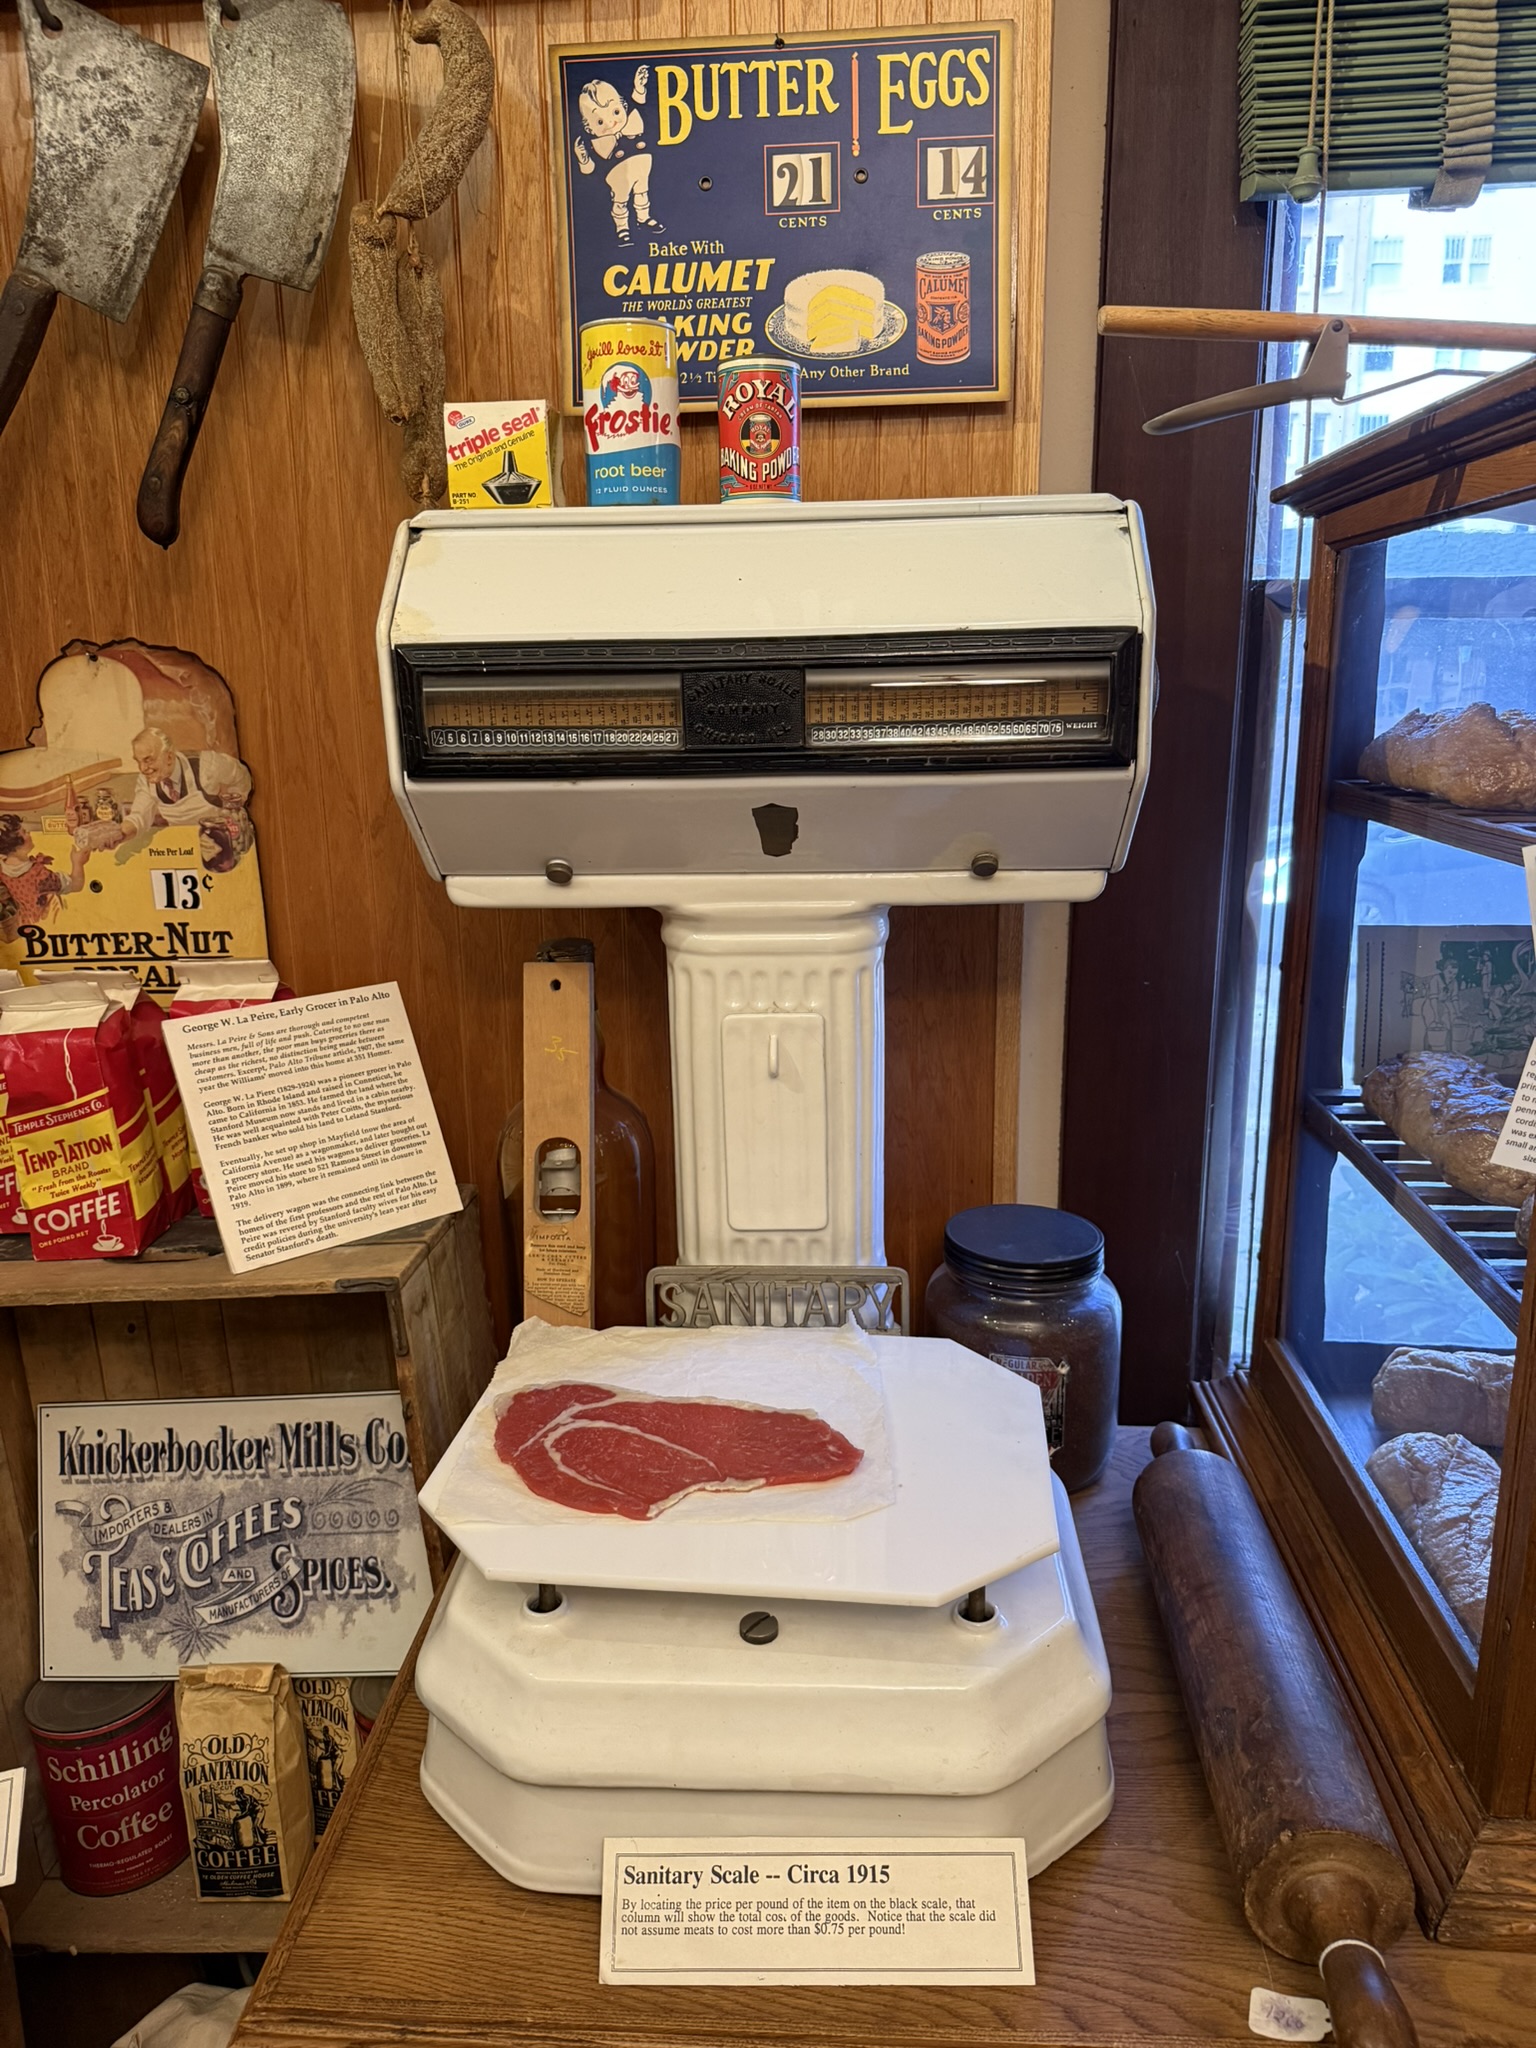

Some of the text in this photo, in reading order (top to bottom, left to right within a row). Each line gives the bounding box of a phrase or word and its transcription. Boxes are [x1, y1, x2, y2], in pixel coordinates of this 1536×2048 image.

[655, 47, 990, 146] BUTTER EGGS
[777, 146, 987, 207] 21 14
[778, 207, 982, 228] CENTS CENTS
[649, 240, 725, 257] Bake With
[602, 258, 776, 297] CALUMET
[919, 277, 968, 300] CALUMET
[621, 295, 753, 313] THE WORLD'S GREATEST
[616, 340, 647, 356] love
[800, 363, 910, 381] Any Other Brand
[722, 379, 796, 421] ROYAL
[448, 407, 540, 462] triple seal
[585, 402, 671, 452] Frostie
[454, 429, 535, 472] The Original and Genuine
[594, 462, 666, 479] root beer
[632, 485, 668, 494] OUNCES
[988, 721, 1098, 734] 52 55 60 65 70 75 WEIGHT
[149, 847, 194, 857] Price Per Loaf
[17, 922, 234, 960] BUTTER-NUT
[182, 991, 390, 1034] George W. La Peire, Early Grocer in Palo Alto
[1522, 1094, 1531, 1102] to
[12, 1120, 46, 1136] TEMPLE
[45, 1106, 91, 1127] STEPHENS
[1511, 1128, 1527, 1138] was
[17, 1133, 113, 1176] TEMP-TATION
[1505, 1139, 1528, 1149] small
[52, 1161, 90, 1179] BRAND
[58, 1177, 75, 1190] from
[76, 1173, 87, 1182] the
[50, 1188, 70, 1199] Twice
[33, 1191, 122, 1235] COFFEE
[38, 1229, 89, 1249] ONE POUND NET
[245, 1231, 339, 1262] Senator Stanford's death.
[659, 1281, 900, 1330] SANITARY
[57, 1425, 271, 1478] Knickerbocker
[276, 1420, 358, 1472] Mills
[94, 1502, 172, 1543] IMPORTERS &
[153, 1507, 213, 1535] DEALERS IN
[83, 1494, 157, 1629] TEAS
[179, 1496, 302, 1590] COFFEES
[228, 1569, 252, 1579] AND
[208, 1565, 292, 1620] MANUFACTURERS OF
[271, 1544, 395, 1620] SPICES.
[299, 1678, 331, 1696] OLD
[47, 1721, 173, 1783] Schilling
[207, 1735, 246, 1756] OLD
[183, 1760, 270, 1790] PLANTATION
[69, 1768, 166, 1812] Percolator
[77, 1801, 173, 1850] Coffee
[197, 1845, 277, 1869] COFFEE
[623, 1864, 704, 1889] Sanitary
[710, 1864, 760, 1885] Scale
[787, 1863, 840, 1884] Circa
[847, 1864, 890, 1884] 1915
[621, 1911, 660, 1923] column
[664, 1911, 684, 1922] will
[688, 1910, 715, 1922] show
[719, 1910, 735, 1922] the
[739, 1910, 762, 1922] total
[790, 1910, 803, 1922] of
[805, 1910, 821, 1921] the
[825, 1910, 860, 1924] goods.
[867, 1910, 903, 1921] Notice
[905, 1910, 926, 1921] that
[929, 1910, 945, 1921] the
[949, 1910, 976, 1921] scale
[979, 1910, 996, 1921] did
[622, 1897, 976, 1912] By locating the price per pound of the item on the black scale, that
[621, 1922, 905, 1937] not assume meats to cost more than $0.75 per pound!
